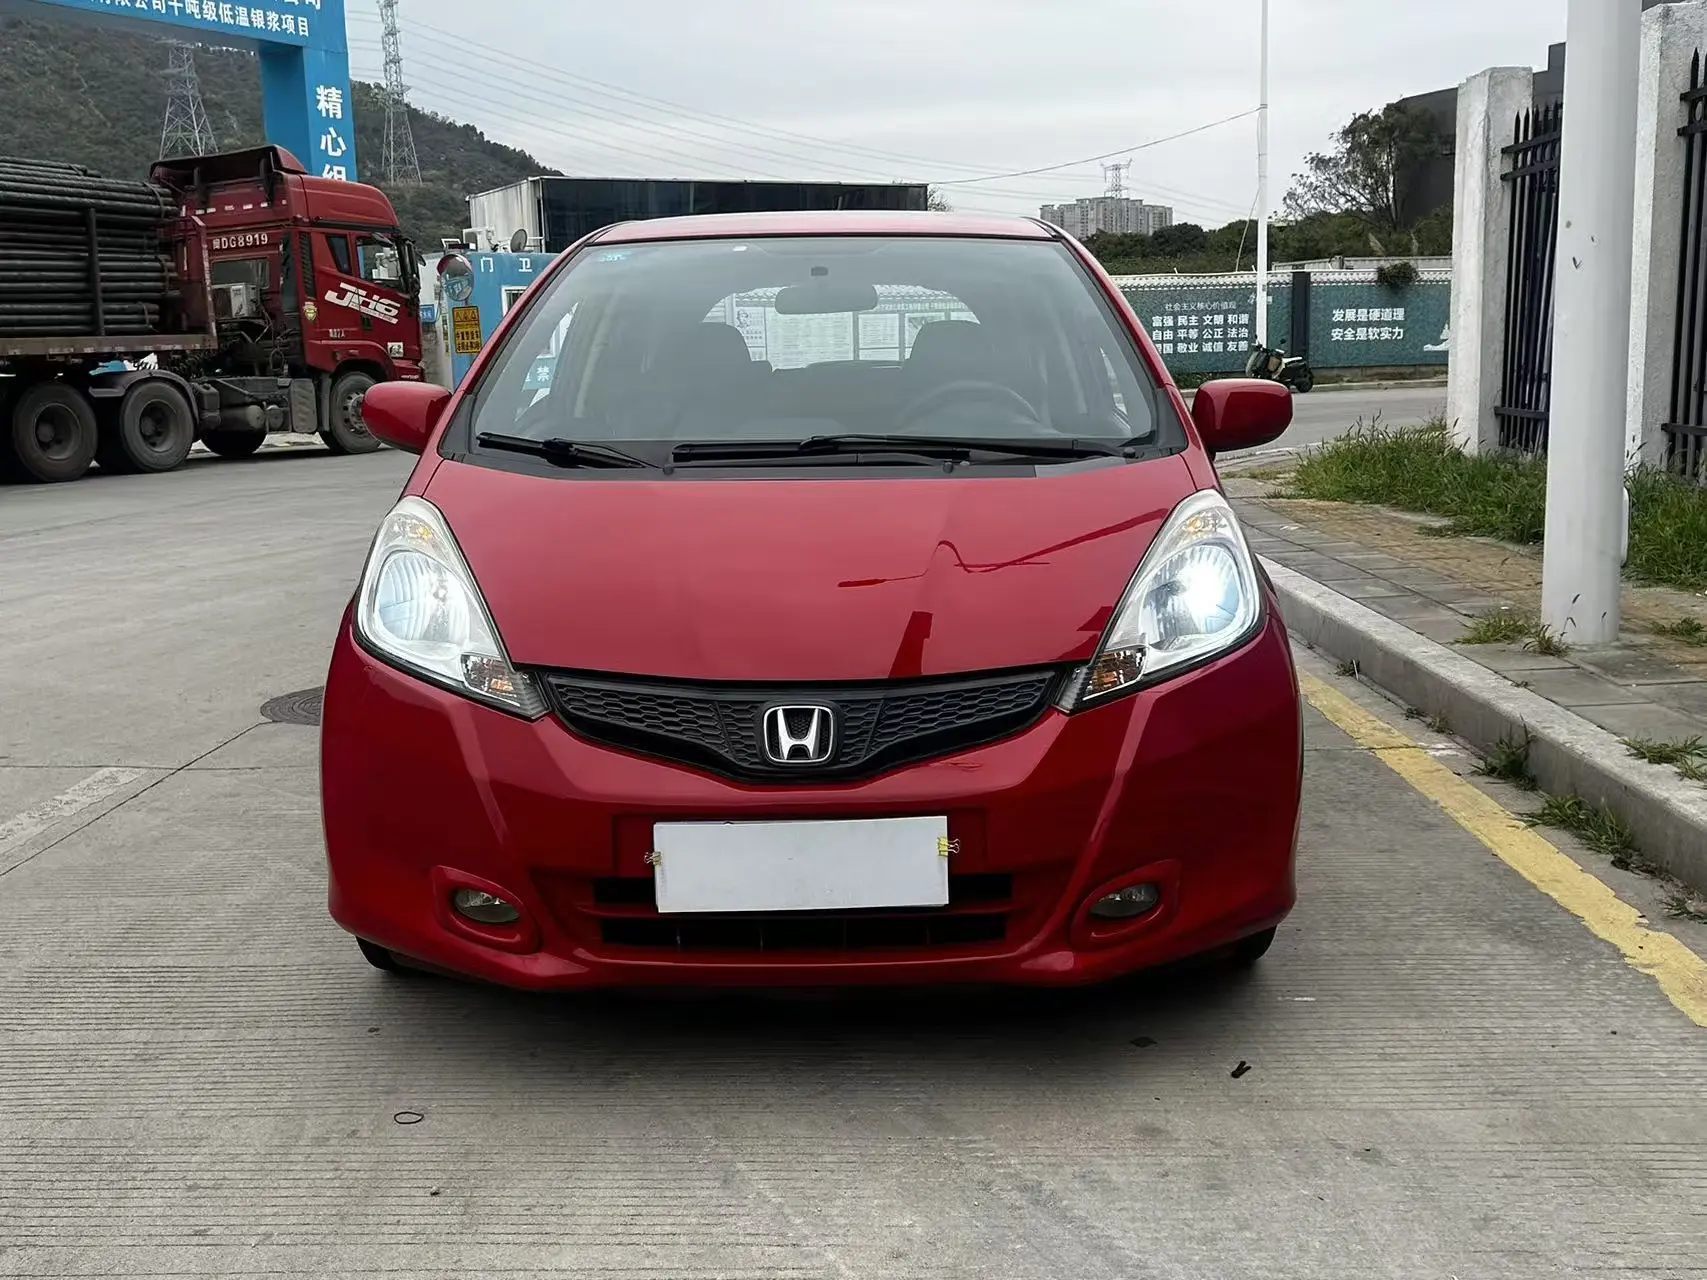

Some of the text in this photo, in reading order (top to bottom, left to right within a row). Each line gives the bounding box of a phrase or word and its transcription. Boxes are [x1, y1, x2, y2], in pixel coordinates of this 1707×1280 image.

[91, 0, 309, 37] 公司千吨级低温银浆项目
[1152, 313, 1249, 327] 富强 民主 文明 和谐
[1332, 307, 1405, 321] 发展是硬道理
[1152, 327, 1249, 341] 自由 平等 公正 法治
[1331, 326, 1404, 341] 安全是软实力
